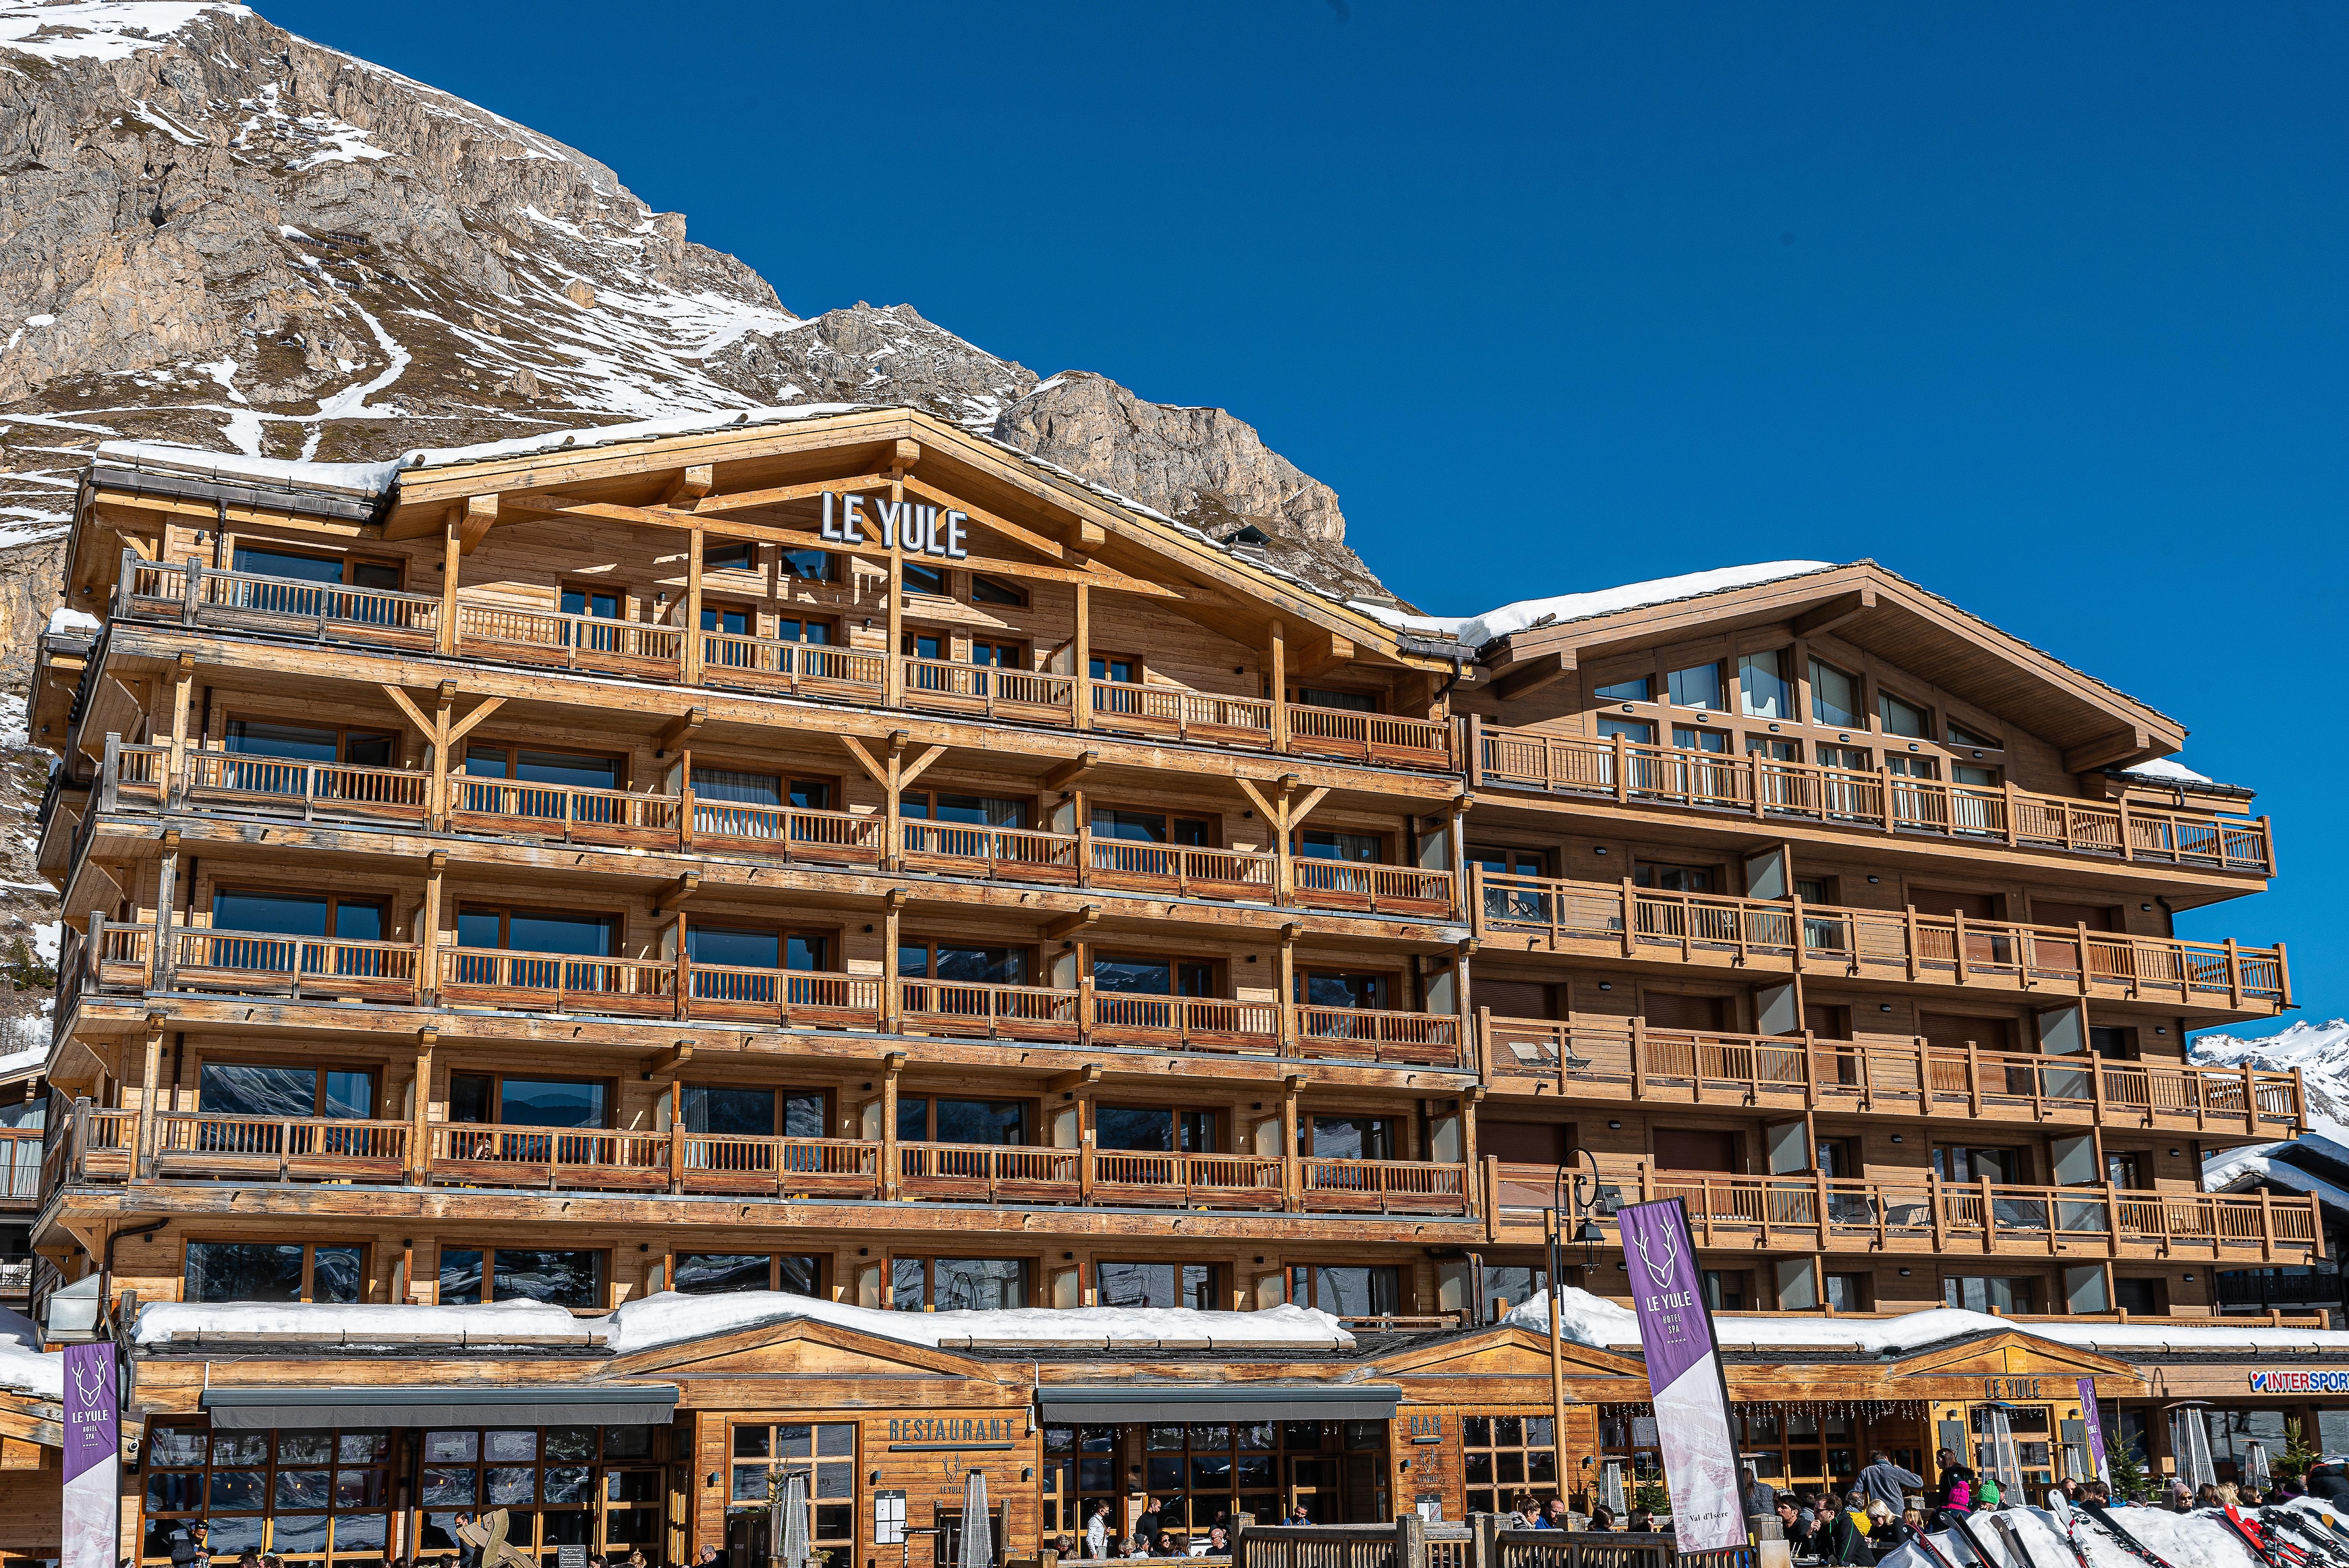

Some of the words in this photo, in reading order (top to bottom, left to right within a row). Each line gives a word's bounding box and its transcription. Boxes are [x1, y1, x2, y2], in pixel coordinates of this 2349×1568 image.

[821, 490, 864, 543] LE
[875, 498, 968, 557] YULE
[1646, 1296, 1660, 1312] LE
[1661, 1291, 1692, 1310] YULE
[1662, 1314, 1681, 1324] HOTEL
[1668, 1325, 1680, 1334] SPA
[1985, 1379, 2002, 1398] LE
[2005, 1379, 2041, 1398] YULE
[2267, 1372, 2349, 1389] INTERSPOR
[72, 1411, 84, 1424] LE
[85, 1409, 108, 1422] YULE
[1411, 1415, 1441, 1435] BAR
[890, 1419, 1013, 1441] RESTAURANT
[1703, 1511, 1728, 1520] d'Isère
